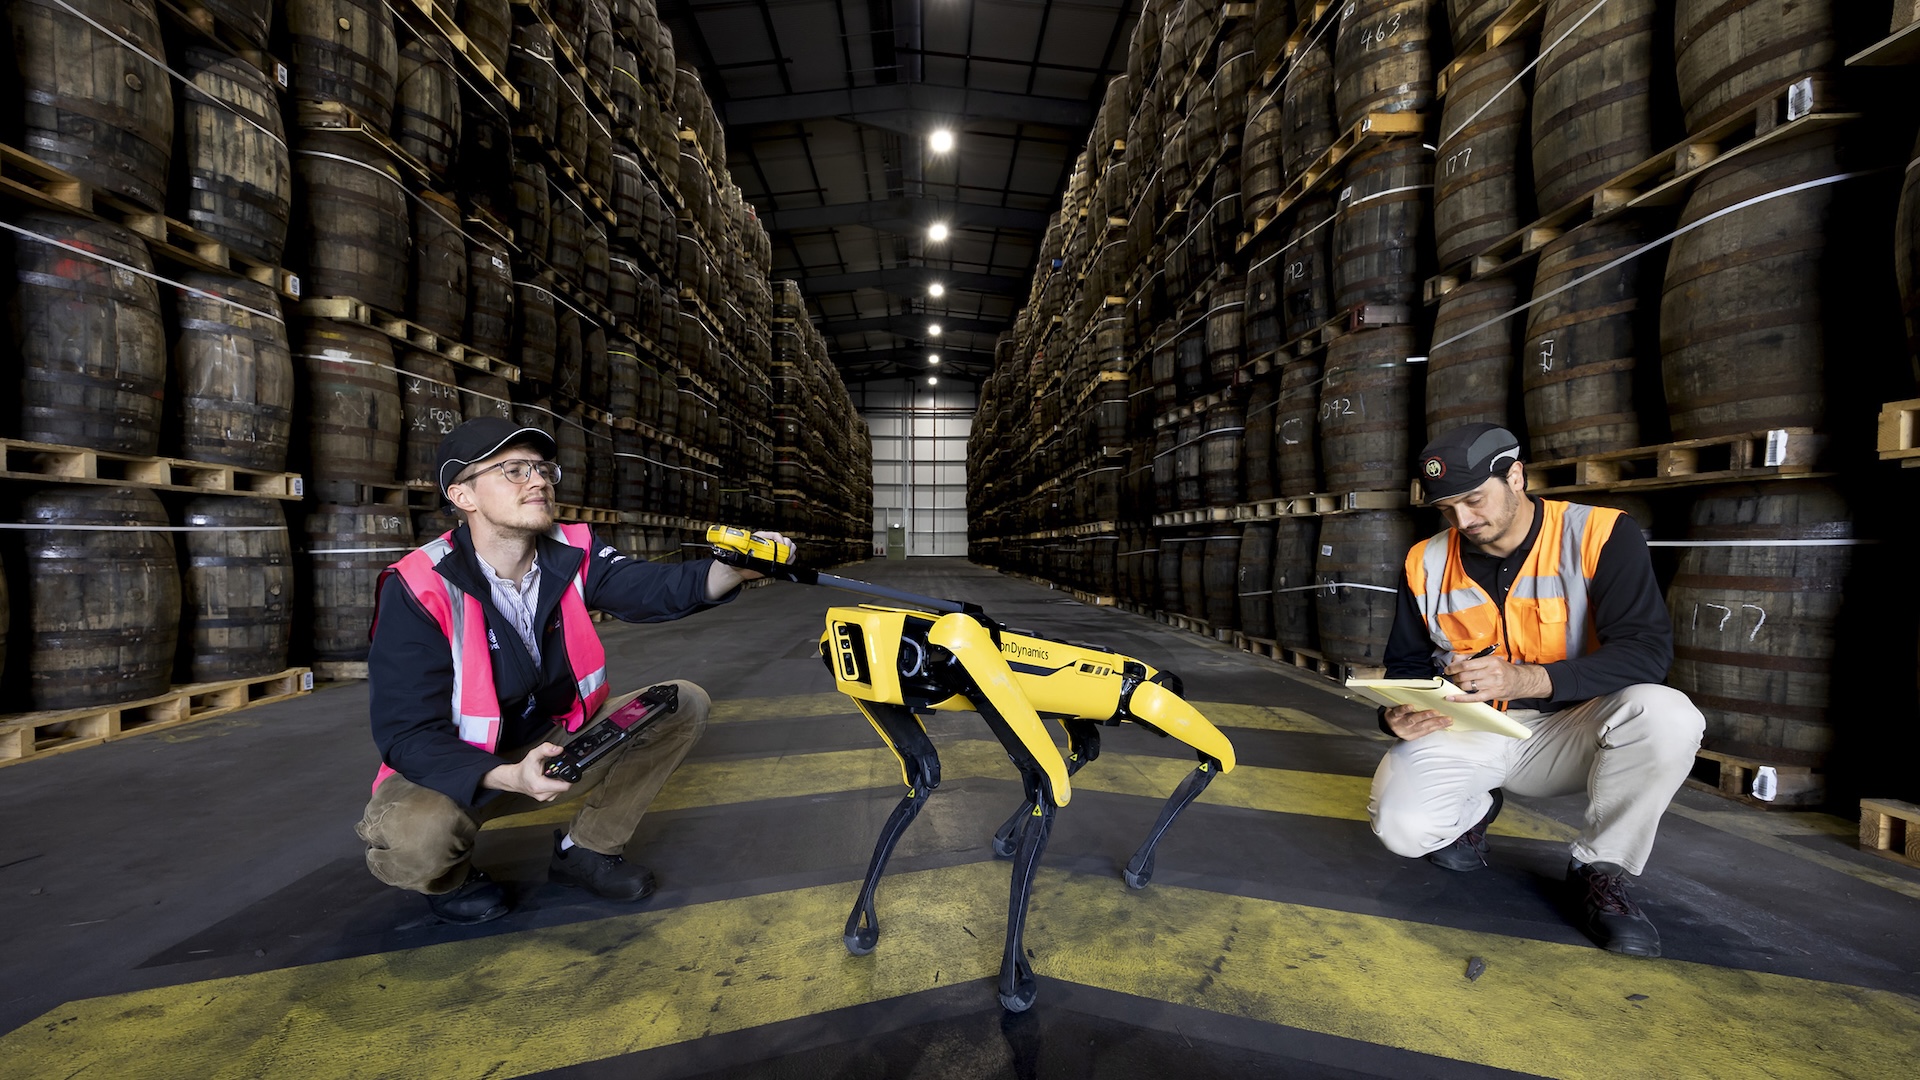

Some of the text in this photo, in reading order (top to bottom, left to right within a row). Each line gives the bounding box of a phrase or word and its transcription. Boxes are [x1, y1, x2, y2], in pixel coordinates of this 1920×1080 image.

[1360, 12, 1401, 51] 463
[1446, 147, 1472, 177] 177
[1692, 603, 1767, 642] 177
